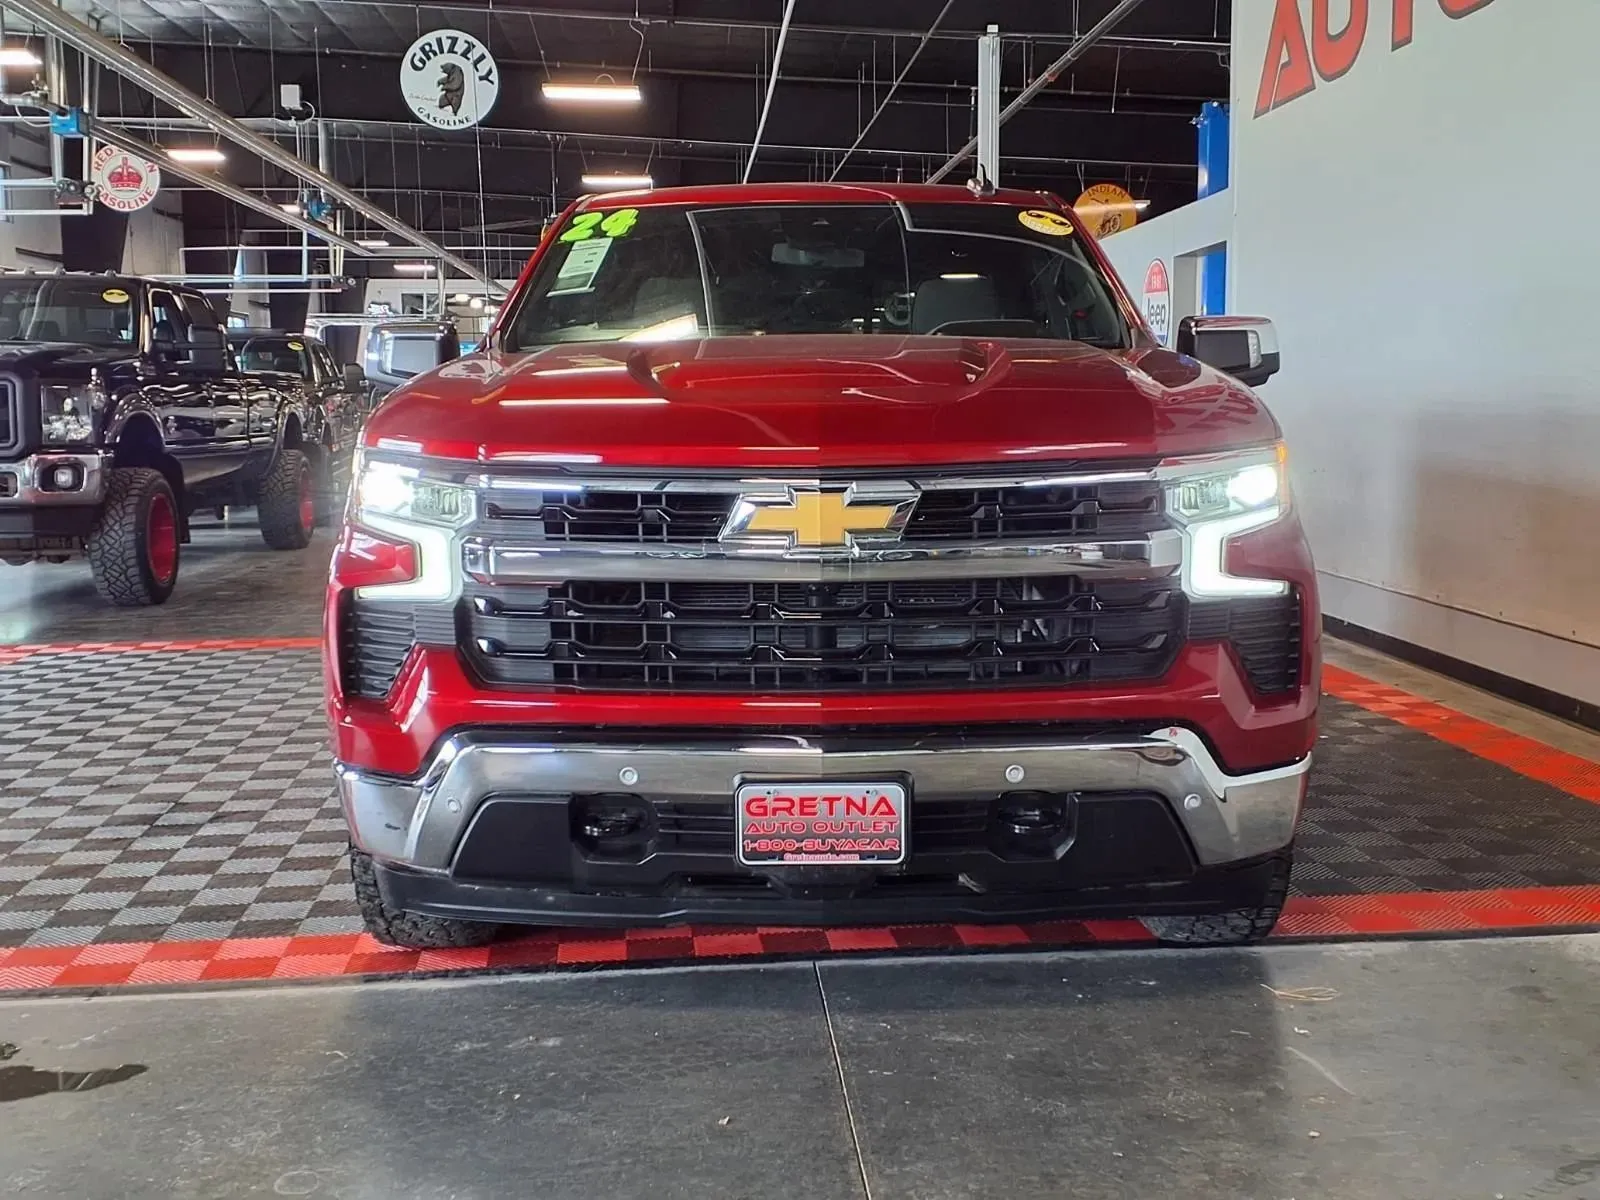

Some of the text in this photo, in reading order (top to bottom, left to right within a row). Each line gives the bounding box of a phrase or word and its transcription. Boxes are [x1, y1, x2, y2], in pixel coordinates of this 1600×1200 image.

[410, 36, 495, 86] GRIZZLY
[1253, 0, 1497, 120] AU
[417, 106, 472, 126] GASOLINE
[94, 147, 114, 171] RED
[1087, 186, 1126, 199] INDIAN
[560, 209, 639, 241] 24
[745, 796, 897, 817] GRETNA
[744, 820, 899, 834] AUTO OUTLET
[744, 838, 899, 852] 1-800-BUYACAR
